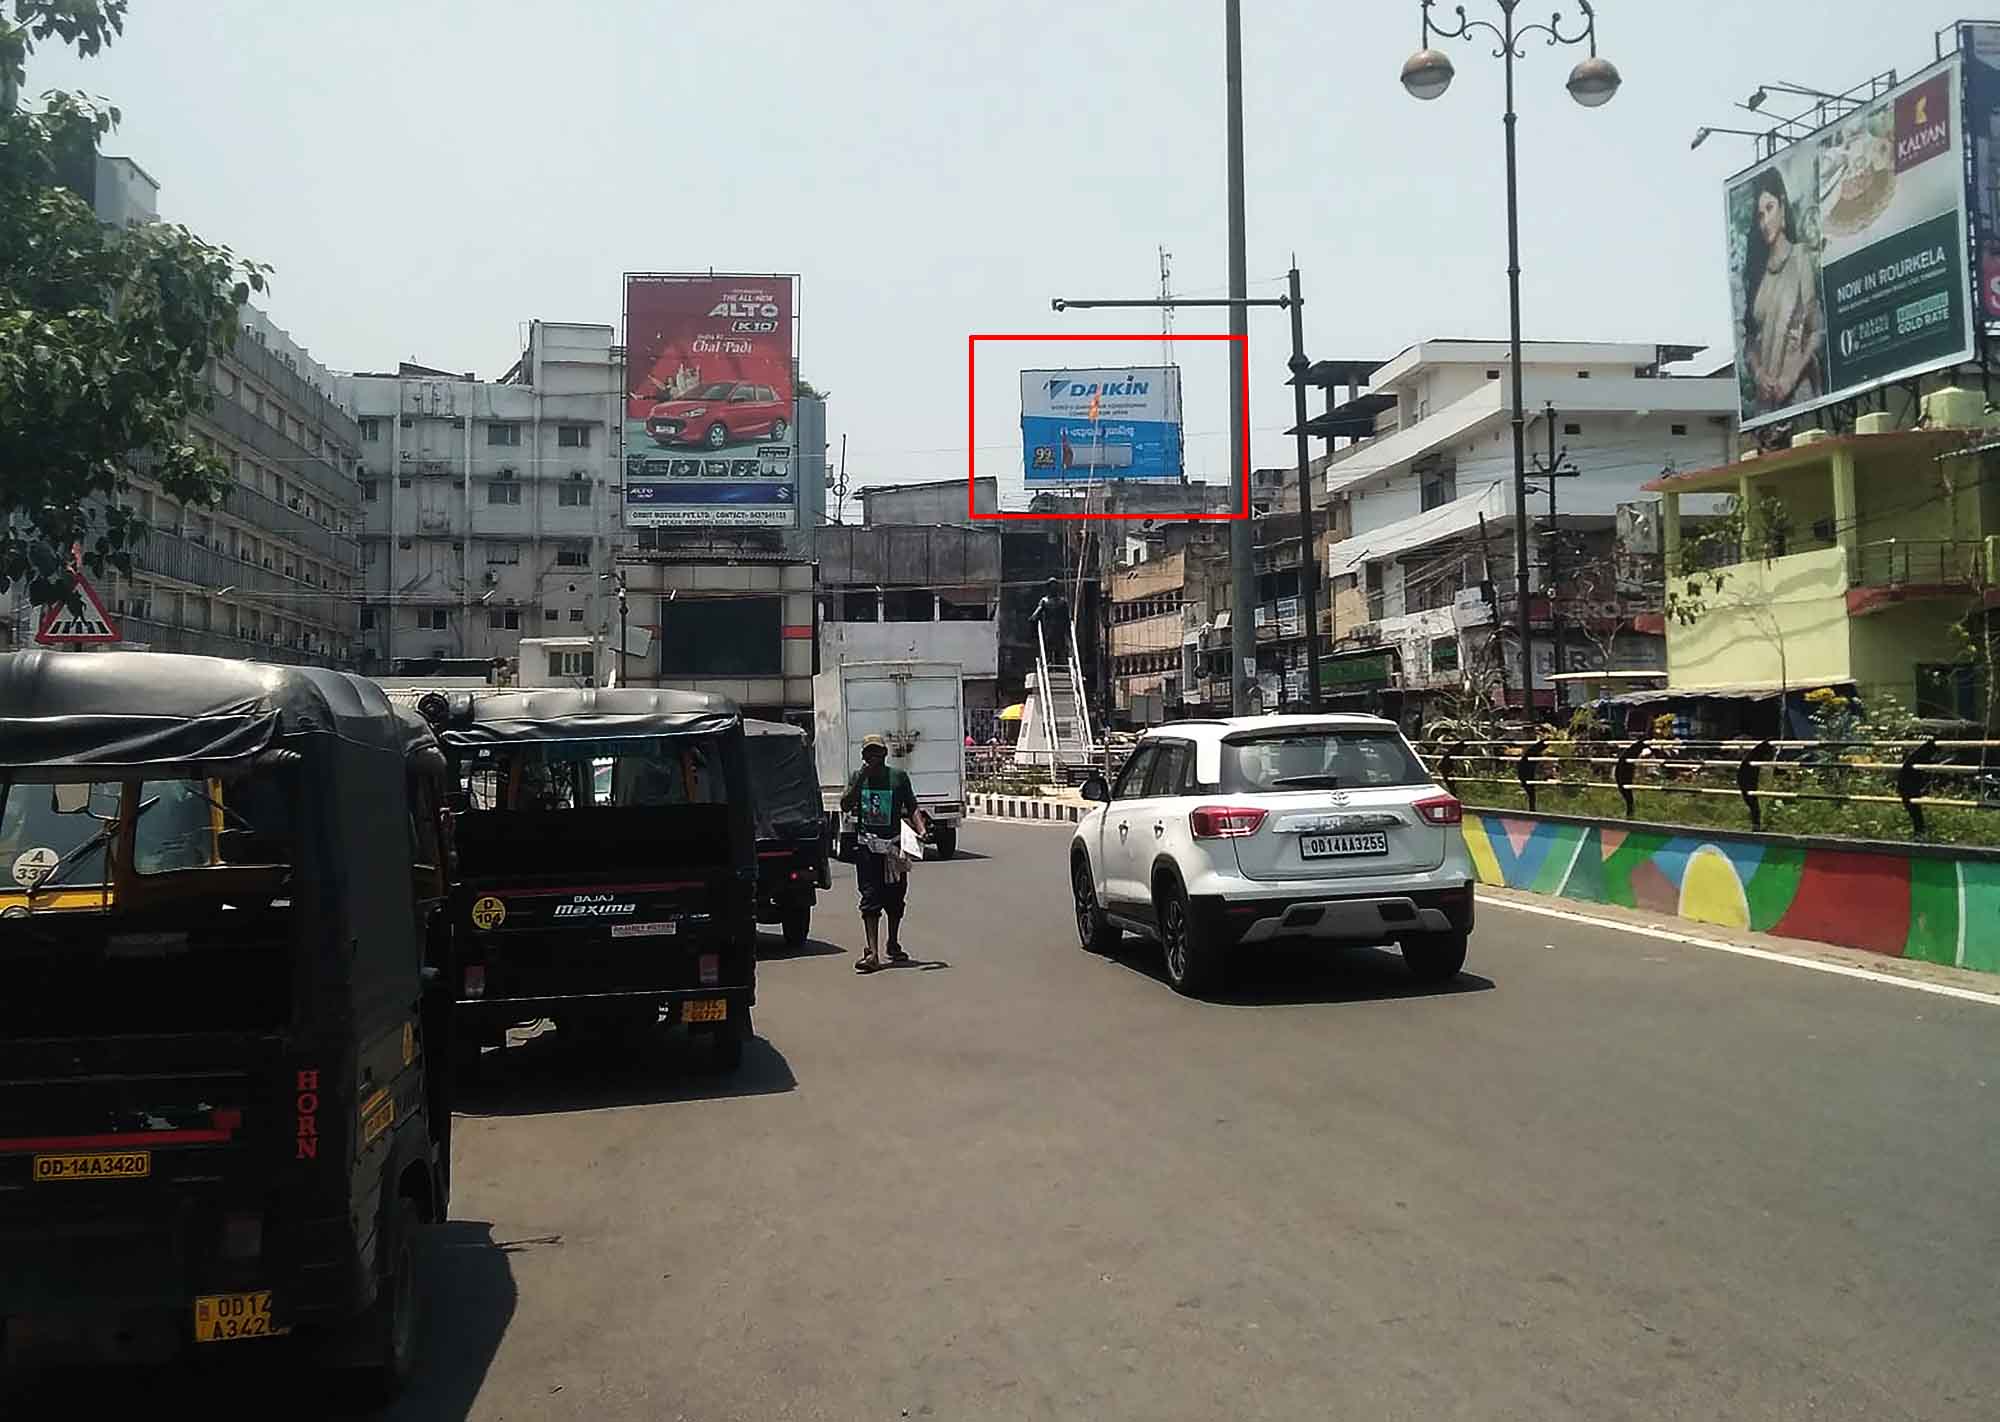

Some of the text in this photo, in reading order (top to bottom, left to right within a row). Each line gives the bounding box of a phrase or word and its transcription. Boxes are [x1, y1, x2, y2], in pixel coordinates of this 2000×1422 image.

[1898, 120, 1946, 159] KALYAN
[1837, 278, 1862, 302] NOW
[1864, 272, 1877, 291] IN
[1879, 246, 1946, 286] ROURKELA
[708, 303, 778, 318] ALTO
[1898, 316, 1923, 335] GOLD
[1924, 308, 1949, 326] RATE
[1070, 375, 1149, 397] DAIKIN
[1310, 835, 1385, 854] OD14AA3255
[31, 850, 44, 863] A
[483, 899, 494, 911] D
[573, 894, 614, 903] BAJAJ
[555, 904, 636, 916] Maxima
[476, 914, 501, 926] 104
[296, 1071, 320, 1159] HORN
[39, 1155, 145, 1177] OD-14A3420
